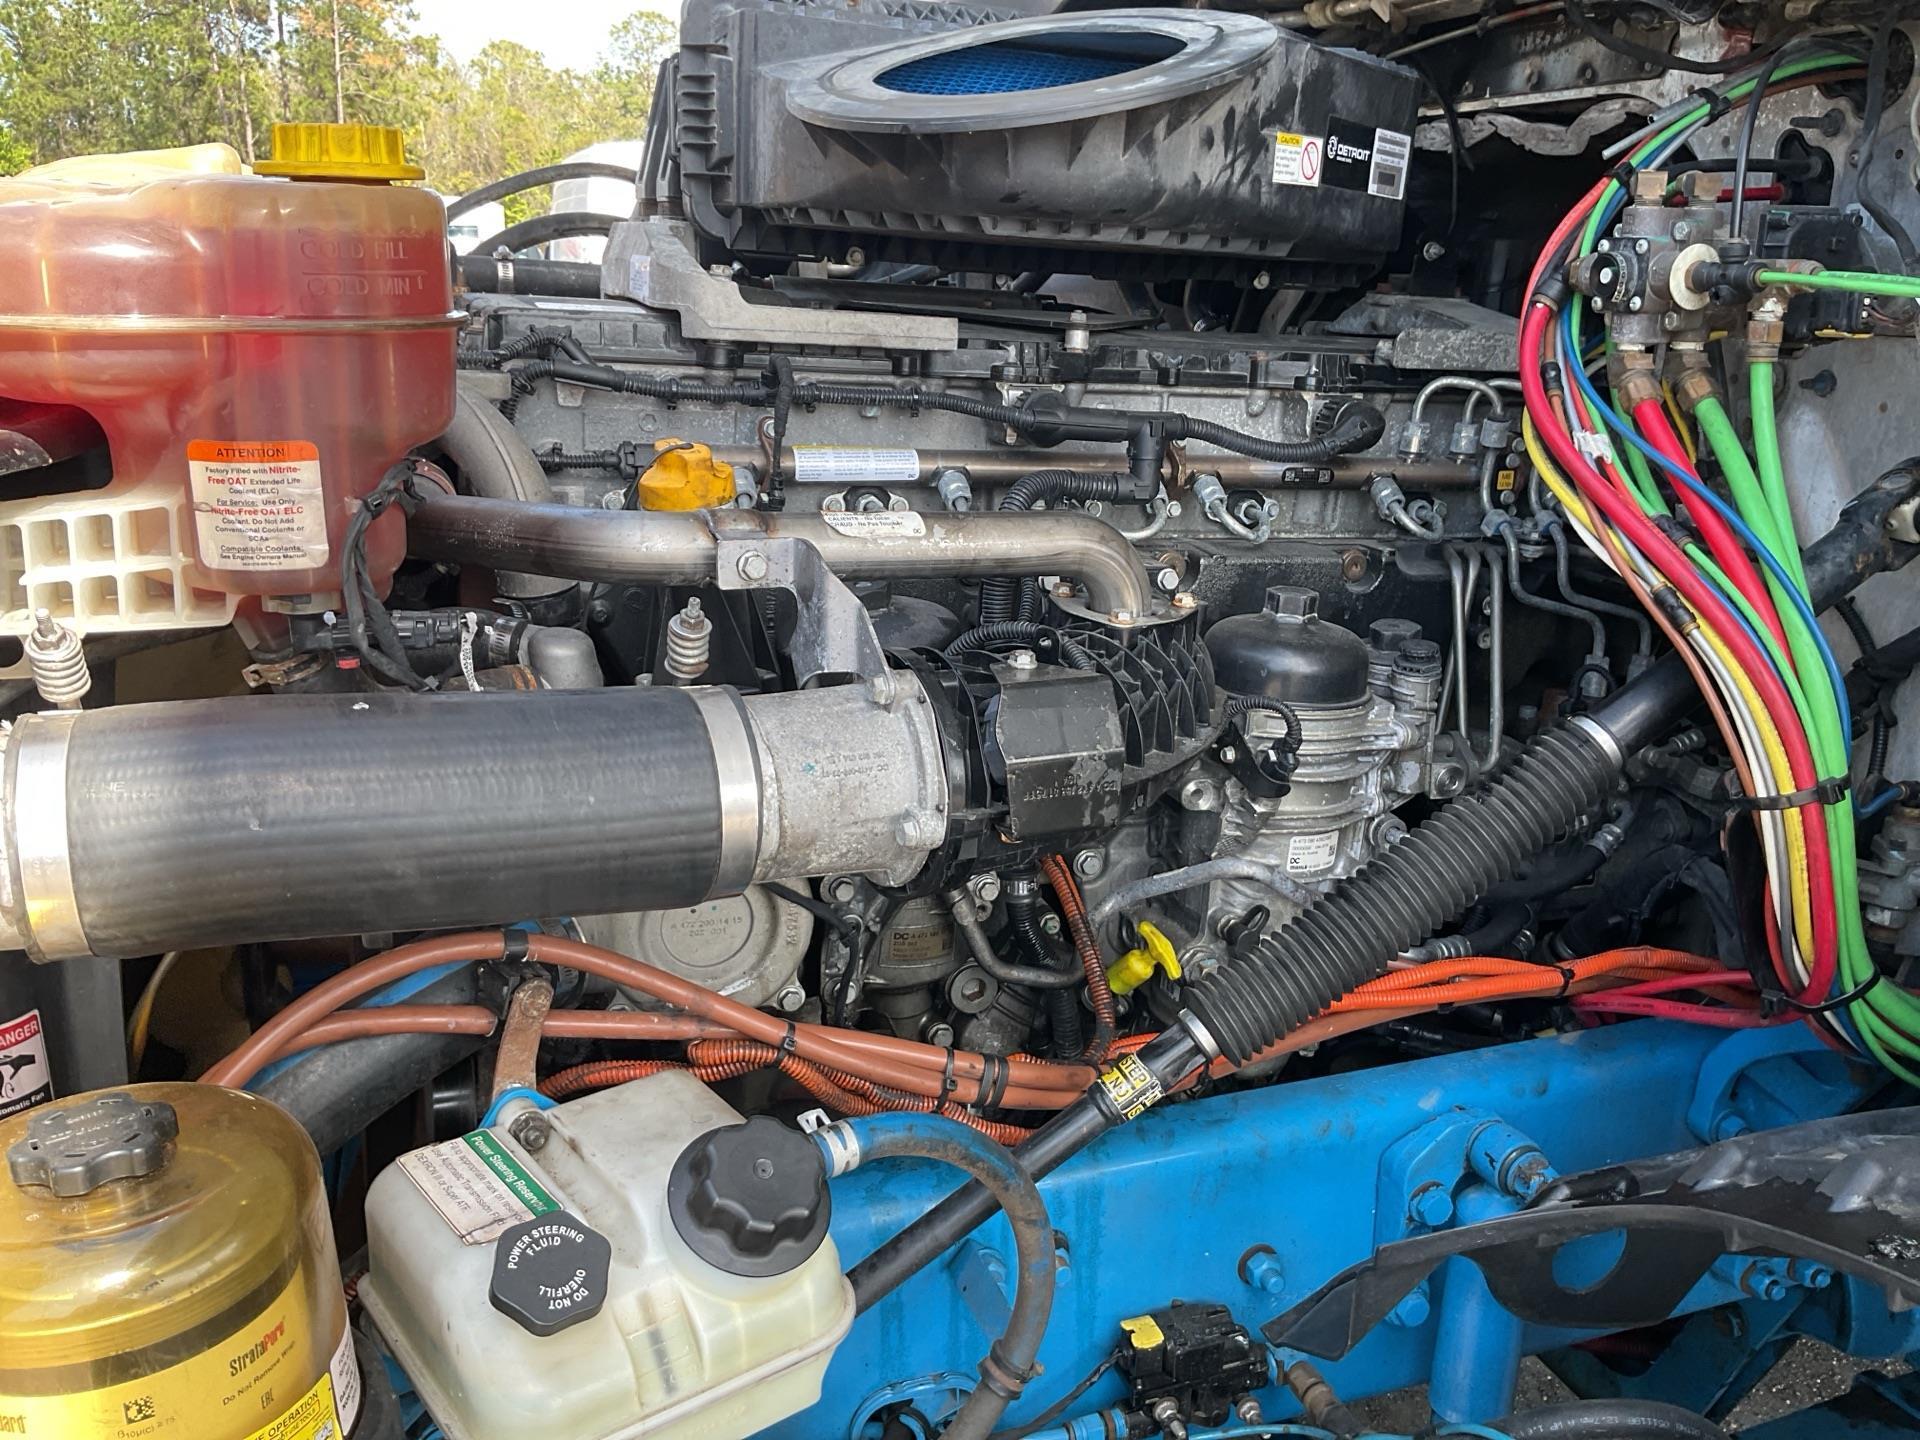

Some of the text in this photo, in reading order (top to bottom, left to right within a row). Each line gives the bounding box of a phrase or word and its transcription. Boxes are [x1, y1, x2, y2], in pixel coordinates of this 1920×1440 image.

[1337, 144, 1370, 161] DETROIT
[301, 240, 409, 259] COLD FILL
[307, 276, 410, 296] COLD MIN
[216, 448, 285, 458] ATTENTION
[205, 466, 229, 475] Factory
[231, 467, 251, 475] Filled
[269, 465, 301, 475] Nitrite-
[208, 476, 225, 485] Free
[228, 477, 247, 485] OAT
[216, 499, 229, 507] For
[278, 499, 296, 507] Only
[260, 507, 281, 516] OAT
[284, 506, 304, 514] ELC
[232, 553, 254, 561] Engine
[1289, 857, 1300, 865] DC
[893, 932, 909, 940] DC
[0, 1020, 39, 1048] ANGER
[1121, 1056, 1148, 1082] STEP
[31, 1091, 45, 1103] Fan
[414, 1152, 436, 1176] DEXRON
[442, 1184, 461, 1204] Super
[458, 1153, 488, 1185] appropriate
[484, 1178, 499, 1196] mark
[470, 1135, 548, 1212] Power Steering Reservoir
[441, 1155, 466, 1182] Automatic
[461, 1178, 493, 1215] Transmission
[507, 1225, 585, 1269] POWER STEERING
[526, 1236, 561, 1256] FLUID
[539, 1269, 586, 1298] OVERFILL
[548, 1287, 589, 1310] DO NOT
[222, 1394, 235, 1406] Do
[237, 1383, 253, 1397] Not
[253, 1356, 281, 1385] Remove
[268, 1389, 319, 1437] OPERATION
